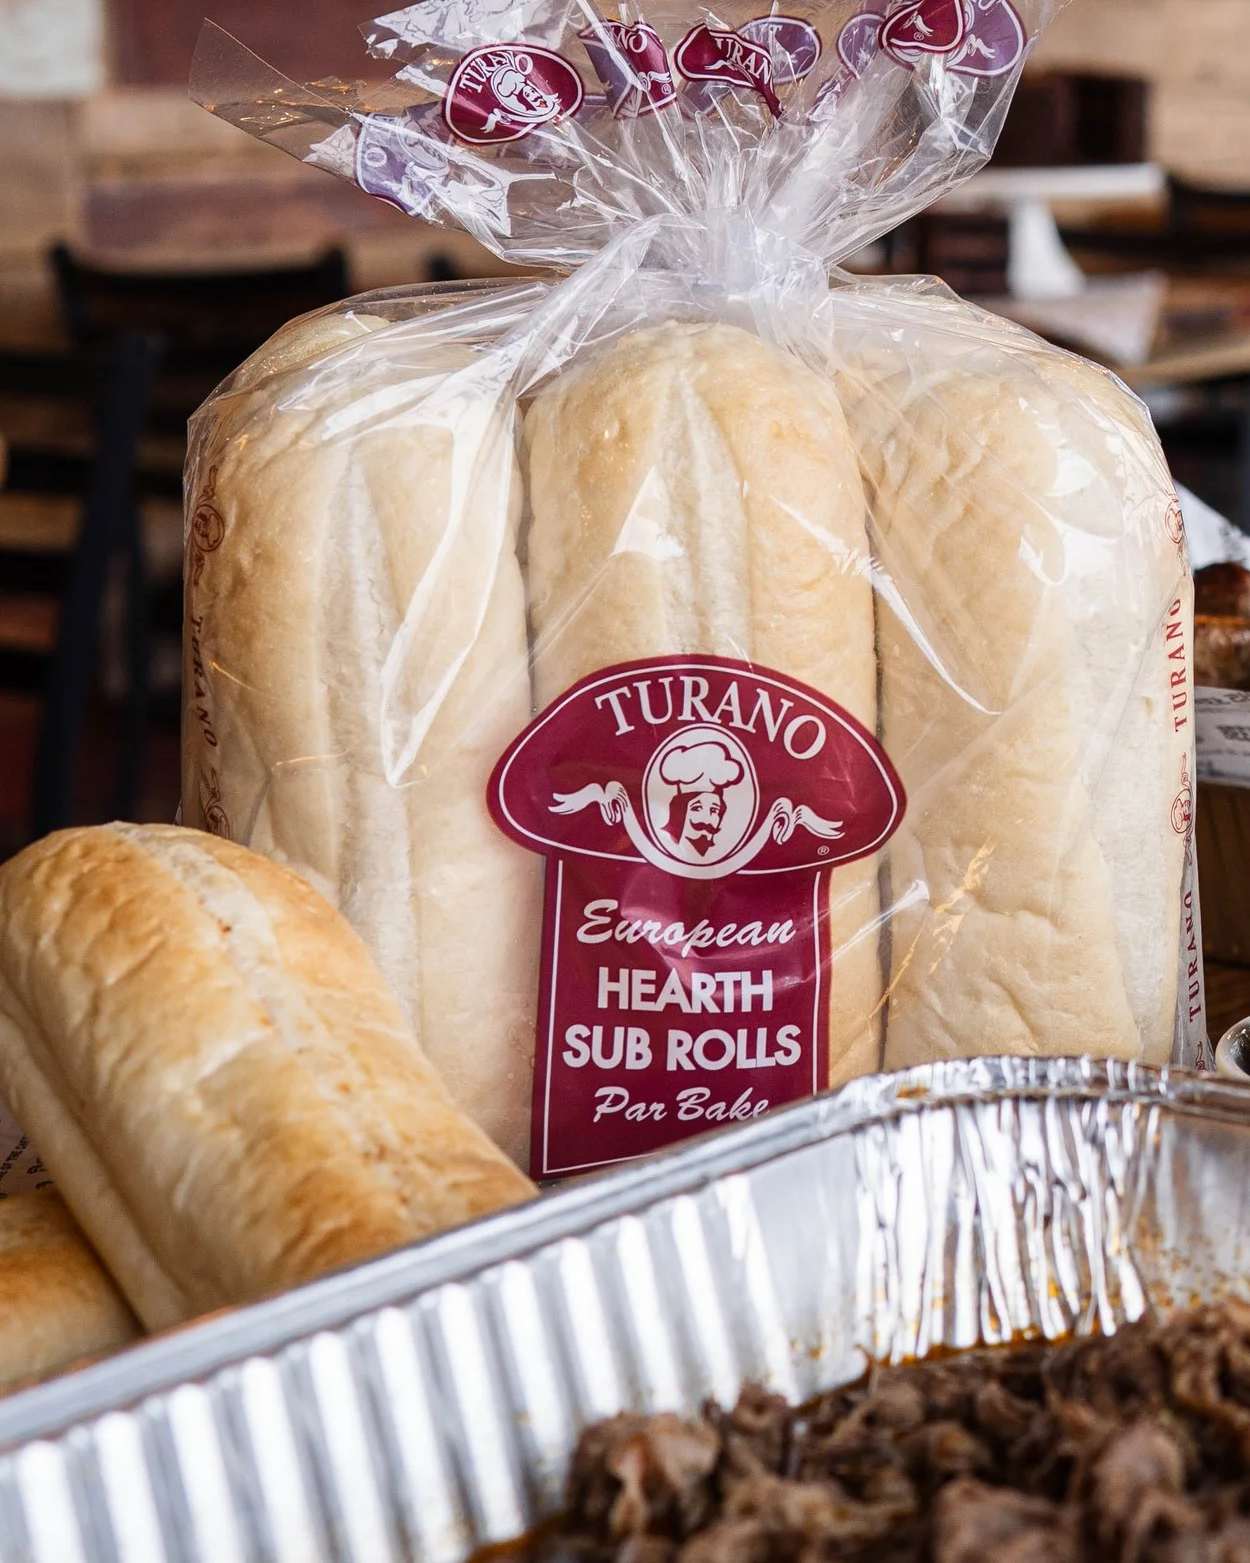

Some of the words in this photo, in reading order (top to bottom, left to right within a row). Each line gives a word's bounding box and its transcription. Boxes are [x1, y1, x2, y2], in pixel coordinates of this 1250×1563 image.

[458, 50, 534, 94] TURANO
[594, 675, 827, 760] TURANO
[576, 899, 798, 959] European
[597, 966, 774, 1014] HEARTH
[562, 1024, 653, 1071] SUB
[666, 1025, 802, 1072] ROLLS
[593, 1086, 670, 1124] Par
[676, 1087, 771, 1123] Bake
